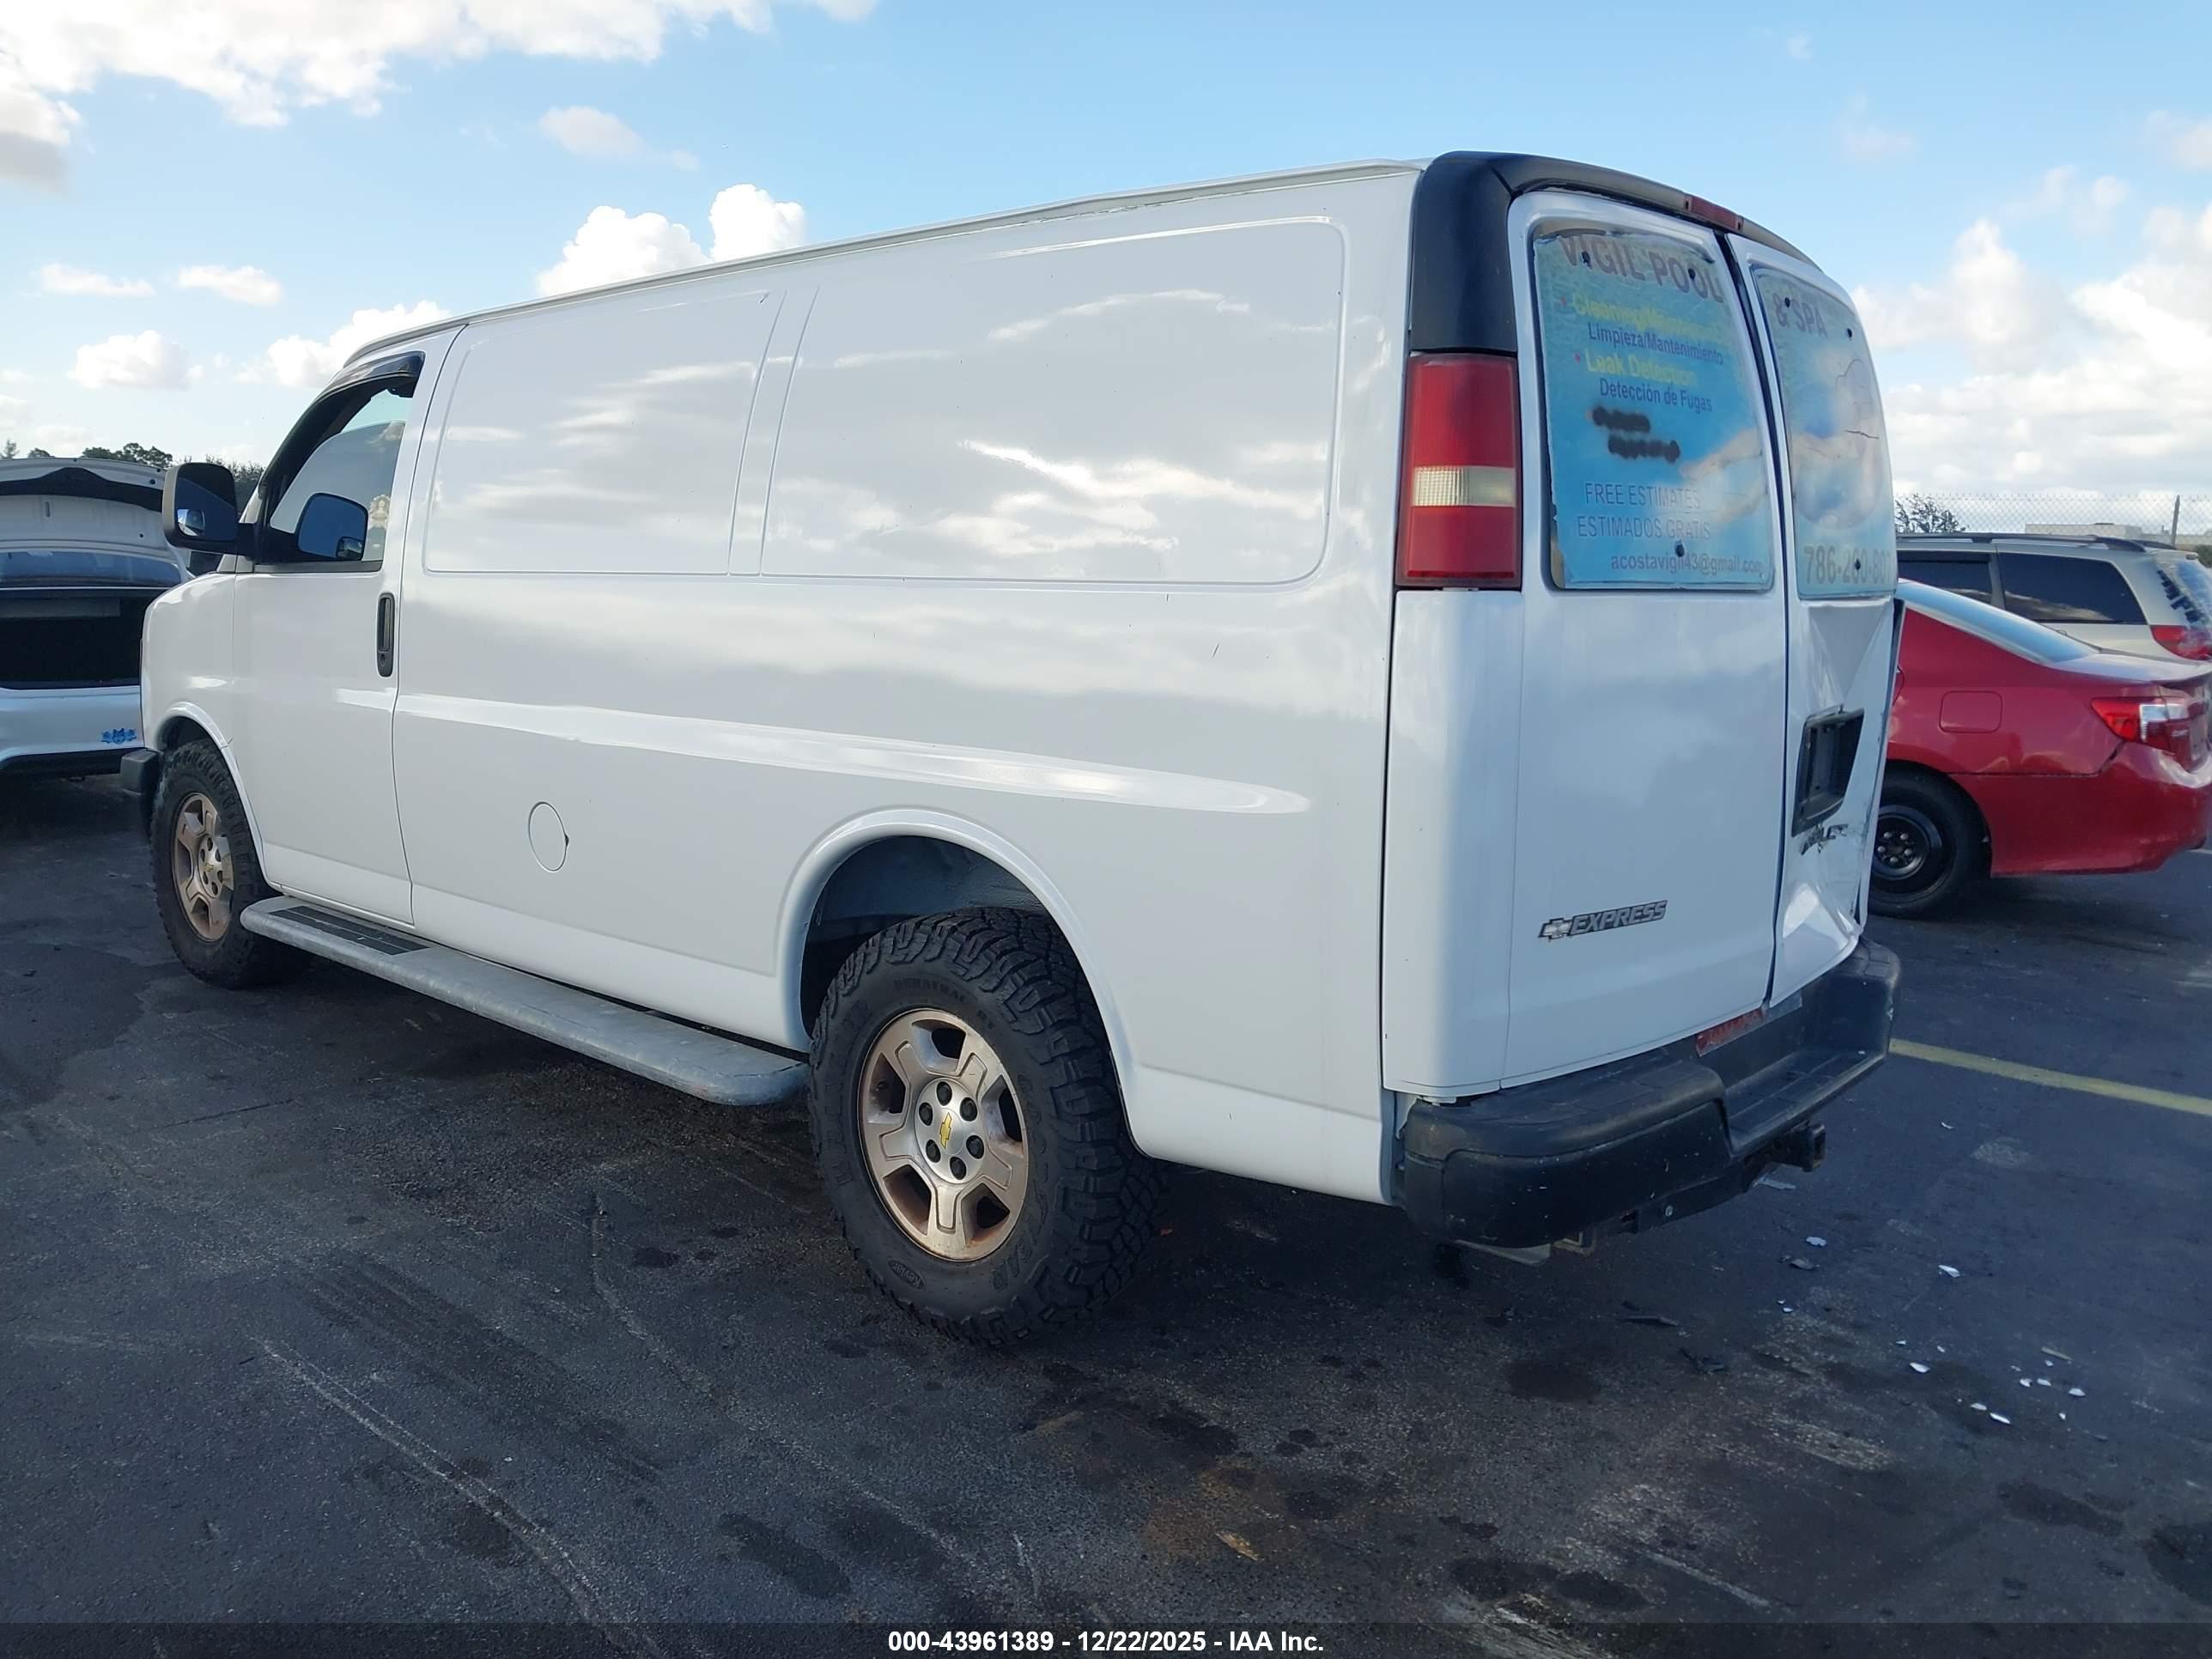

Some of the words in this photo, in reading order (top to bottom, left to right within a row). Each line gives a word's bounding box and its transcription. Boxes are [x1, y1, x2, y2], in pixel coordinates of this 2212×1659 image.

[1648, 250, 1724, 304] POOL
[1790, 298, 1828, 339] SPA
[1599, 377, 1661, 404] Detección
[1663, 386, 1677, 406] de
[1680, 390, 1712, 414] Fugas
[1584, 483, 1624, 506] FREE
[1629, 485, 1701, 510] ESTIMATES
[1577, 515, 1662, 538] ESTIMADOS
[1665, 519, 1711, 541] GRATIS
[1570, 901, 1667, 935] EXPRESS
